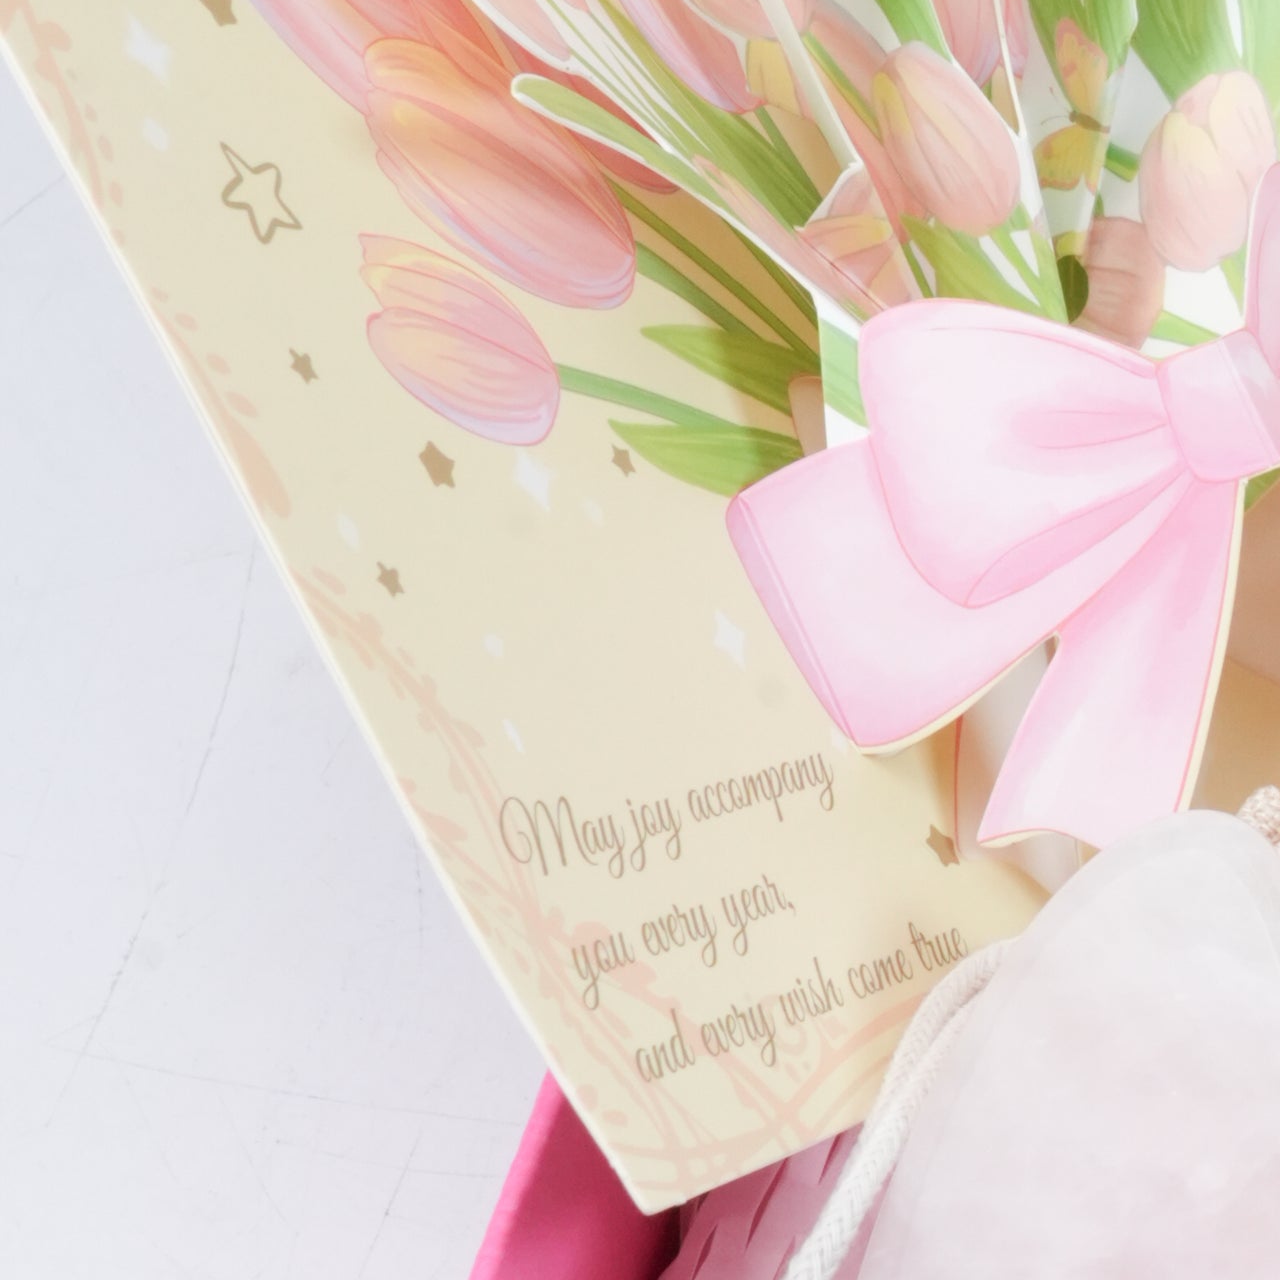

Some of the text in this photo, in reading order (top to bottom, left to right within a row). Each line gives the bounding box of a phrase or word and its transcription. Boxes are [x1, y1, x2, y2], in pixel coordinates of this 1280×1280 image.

[499, 751, 835, 878] May joy accompany
[571, 873, 796, 1011] you every year,
[635, 920, 969, 1083] and every wish come true
